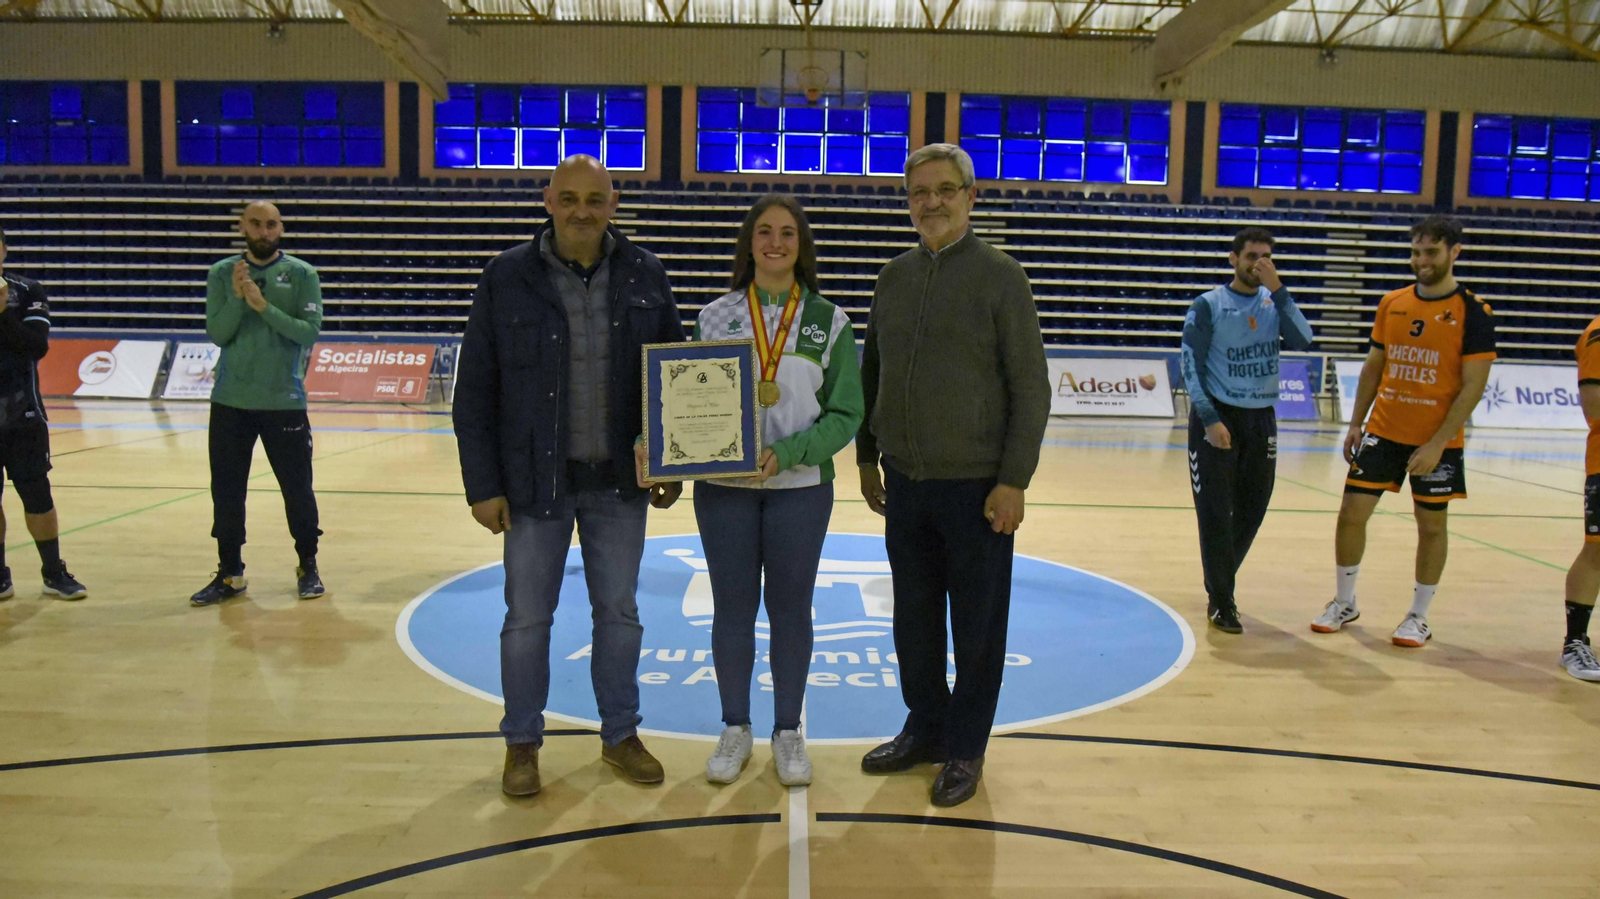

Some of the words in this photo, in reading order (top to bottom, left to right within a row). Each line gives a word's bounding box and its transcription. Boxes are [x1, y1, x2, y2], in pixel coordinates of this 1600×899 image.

[812, 332, 825, 341] BM
[1409, 319, 1425, 337] 3
[317, 348, 427, 365] Socialistas
[1227, 339, 1279, 361] CHECKIN
[1388, 344, 1440, 366] CHECKIN
[315, 365, 326, 373] de
[328, 365, 369, 373] Algeciras
[1228, 359, 1279, 378] HOTELES
[376, 385, 397, 393] PSOE
[1058, 372, 1137, 393] Adedi
